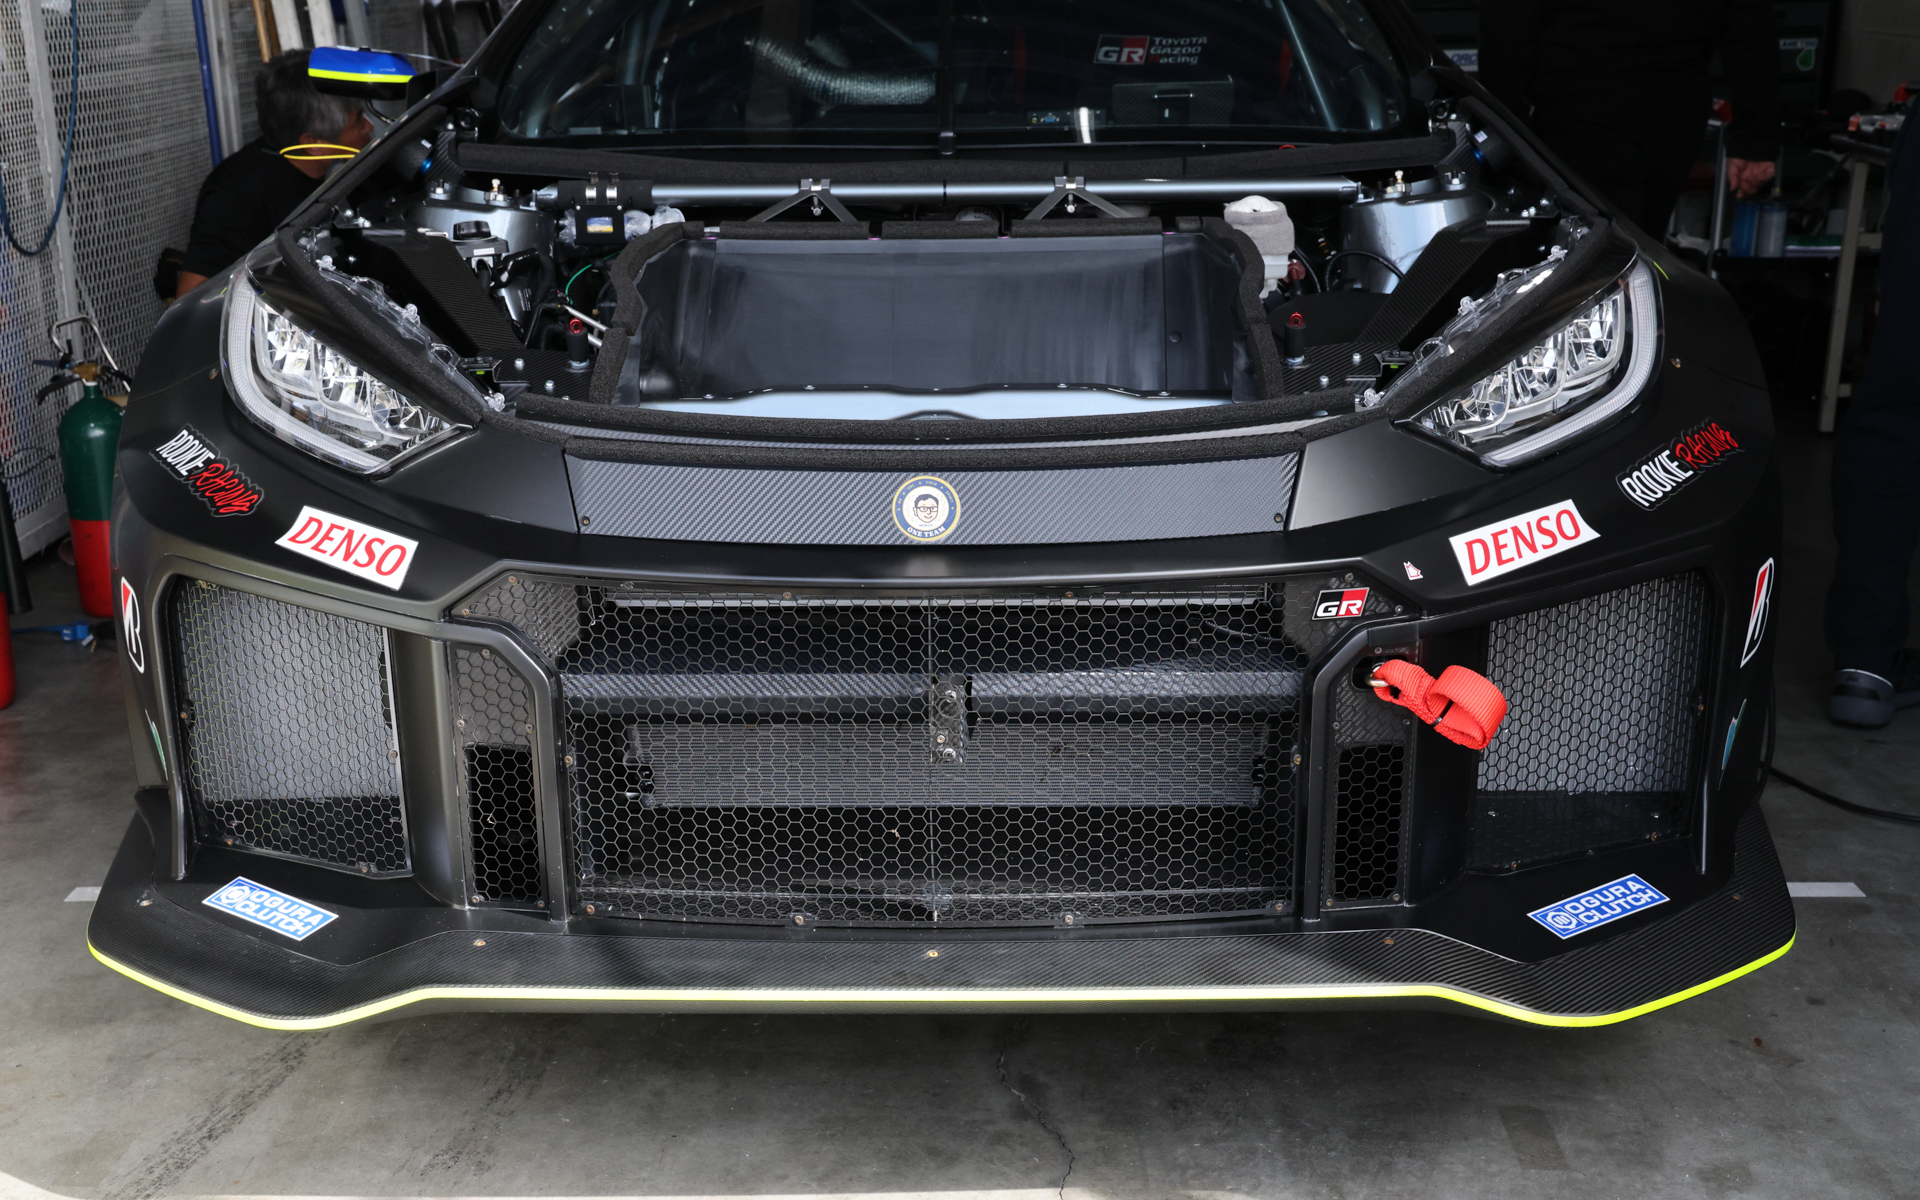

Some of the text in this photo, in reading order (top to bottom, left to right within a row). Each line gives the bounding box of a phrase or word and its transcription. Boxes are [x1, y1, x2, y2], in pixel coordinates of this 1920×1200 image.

[1097, 46, 1144, 62] GR
[1150, 46, 1202, 55] GAZOO
[1153, 36, 1208, 46] TOYOTA
[1149, 55, 1199, 66] Racing
[155, 429, 259, 513] ROOKIE RACING
[1621, 422, 1739, 507] ROOKIE RACING
[286, 516, 407, 576] DENSO
[907, 525, 946, 538] ONE TEAM
[1464, 509, 1581, 576] DENSO
[1316, 600, 1362, 617] GR
[249, 890, 323, 926] OGURA
[1564, 880, 1646, 914] OGURA
[1578, 889, 1660, 923] CLUTCH
[234, 900, 313, 935] CLUTCH
